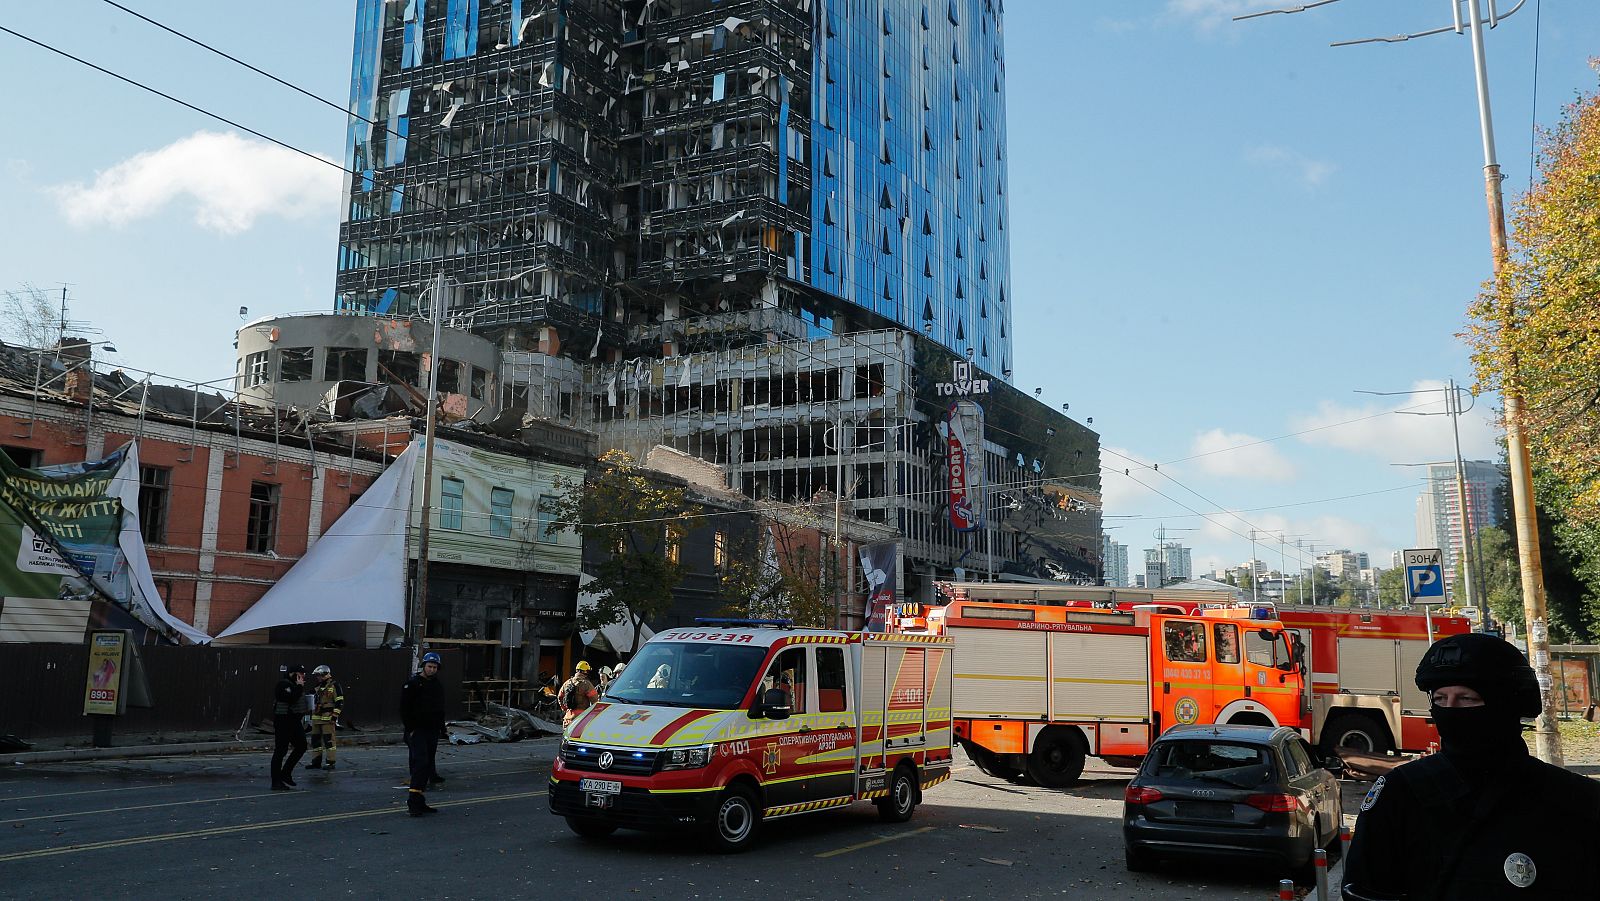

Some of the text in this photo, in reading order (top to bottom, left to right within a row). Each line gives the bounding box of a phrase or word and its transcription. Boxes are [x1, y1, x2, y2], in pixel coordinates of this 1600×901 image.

[935, 380, 989, 397] TOWER
[1410, 554, 1439, 564] ЗОНА
[1411, 569, 1437, 593] P
[1017, 622, 1093, 632] АВАРІЙНО-РЯТУВАЛЬНА
[90, 690, 107, 699] 890
[905, 688, 921, 703] 101
[778, 731, 853, 746] ОПЕРАТИВНО-РЯТУВАЛЬНА
[730, 740, 750, 755] 101
